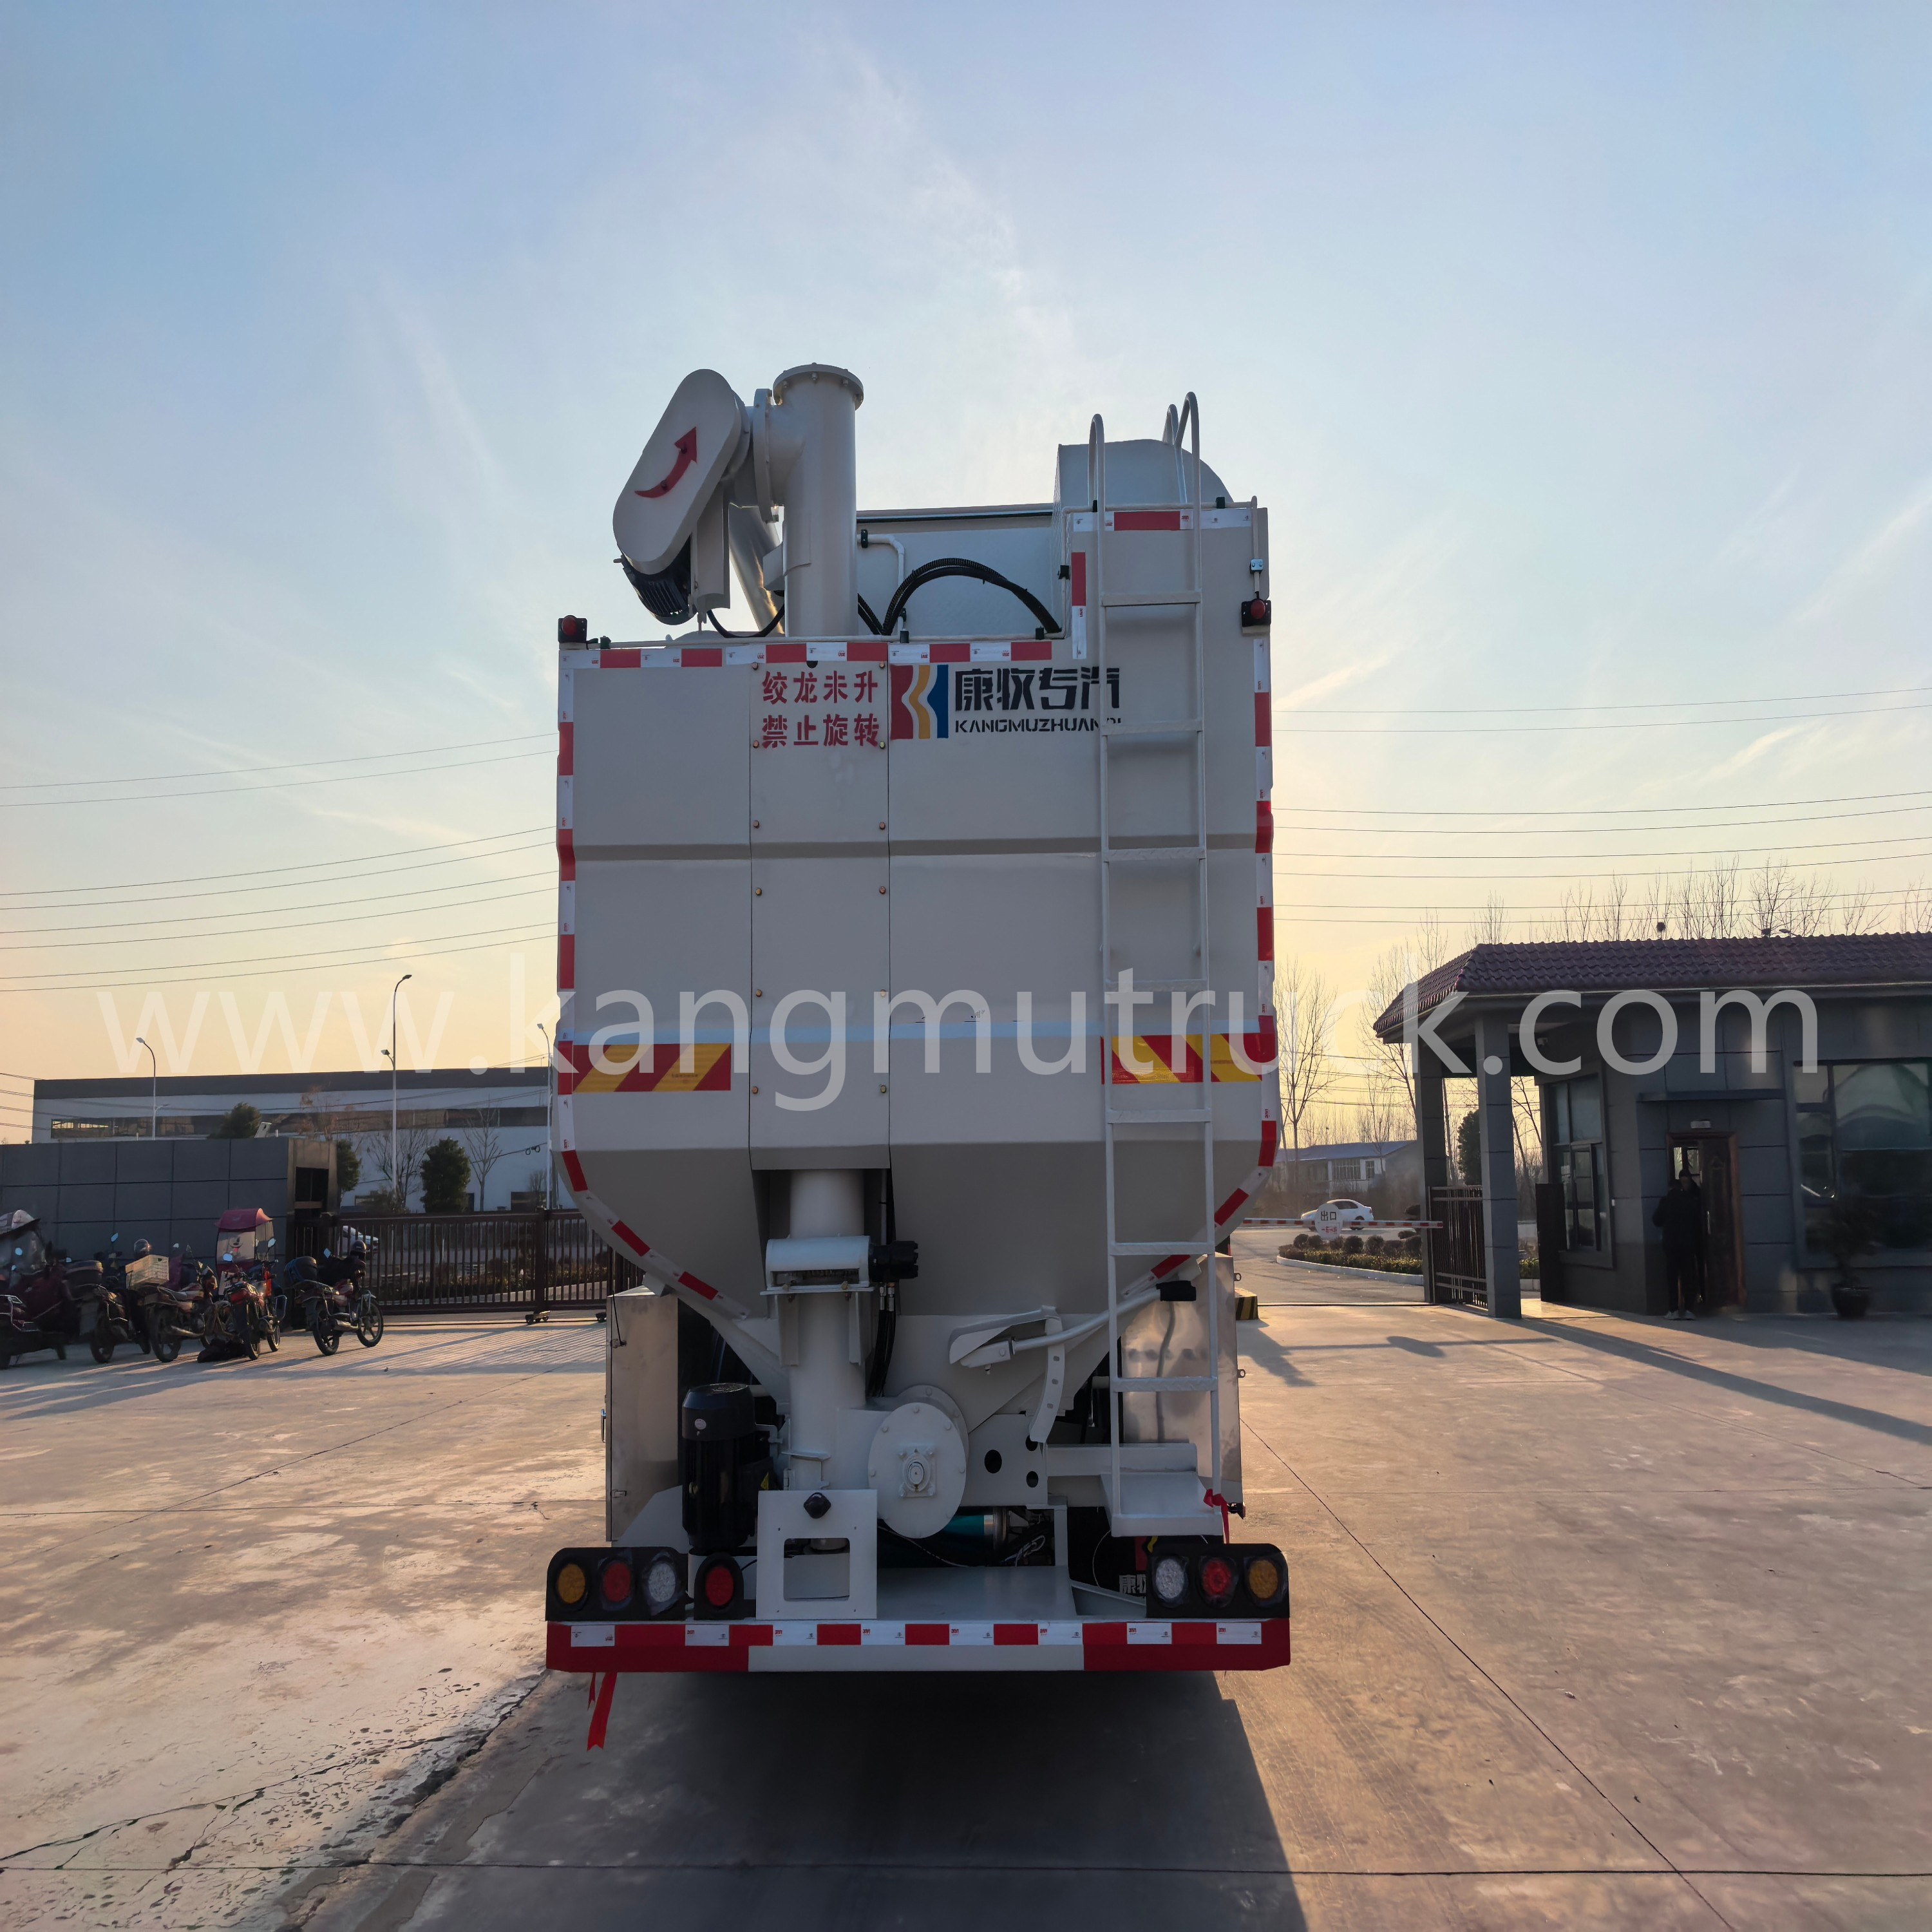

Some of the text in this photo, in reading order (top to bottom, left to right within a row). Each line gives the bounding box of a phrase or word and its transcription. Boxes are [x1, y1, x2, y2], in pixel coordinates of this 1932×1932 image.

[762, 670, 878, 705] 绞龙未升
[955, 666, 1120, 711] 康牧专汽
[762, 713, 880, 748] 禁止旋转
[1321, 1211, 1336, 1221] 出口
